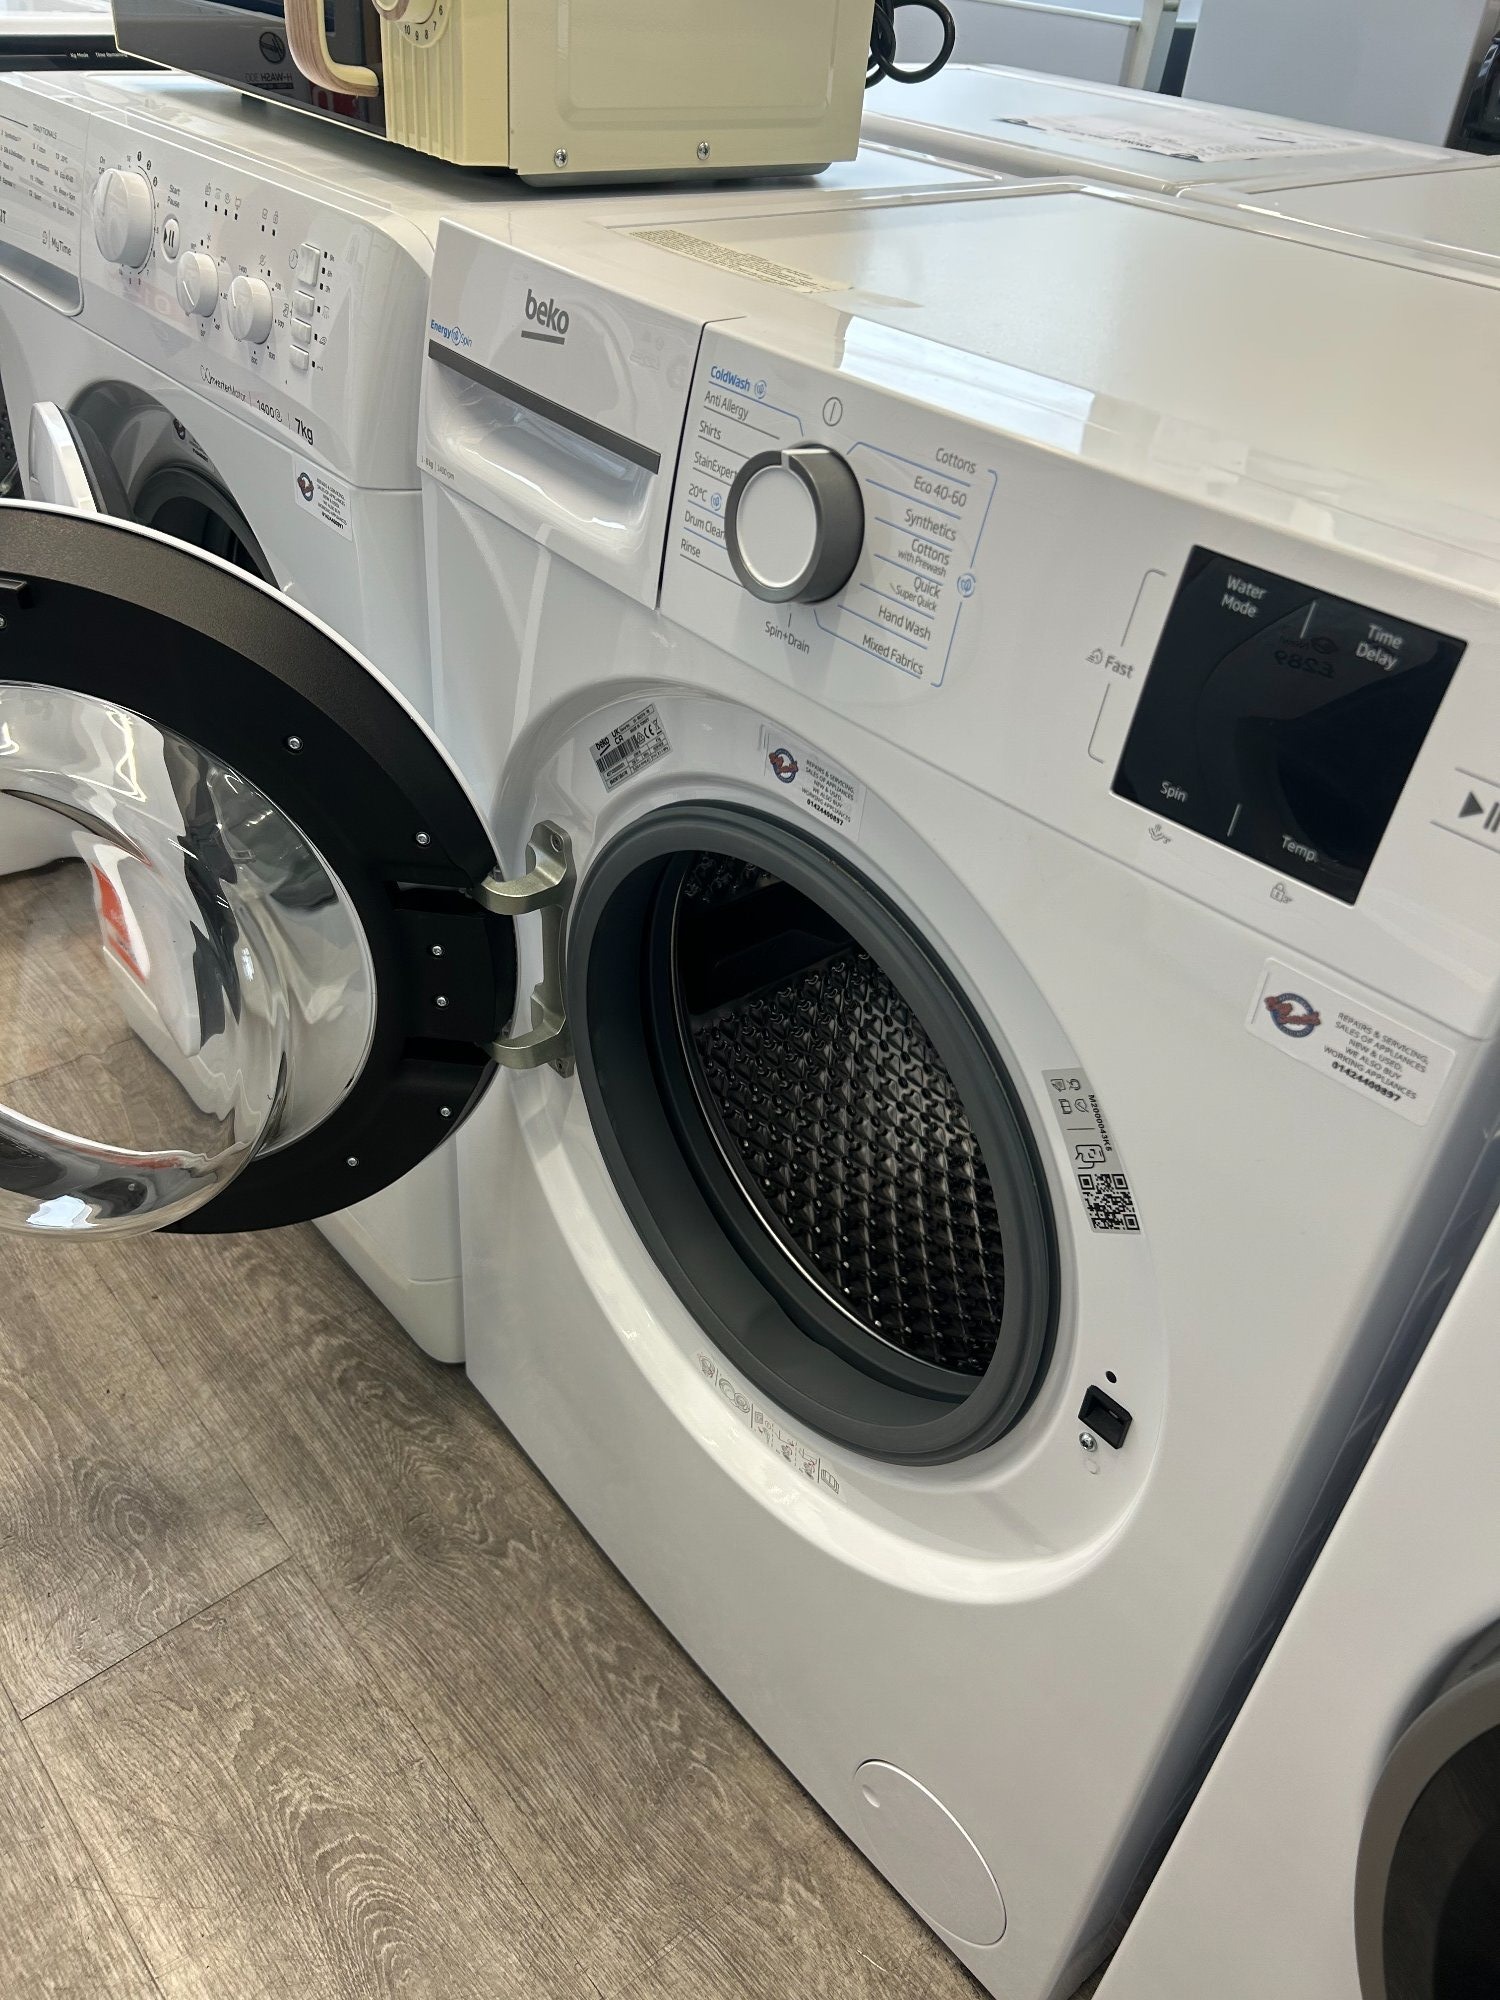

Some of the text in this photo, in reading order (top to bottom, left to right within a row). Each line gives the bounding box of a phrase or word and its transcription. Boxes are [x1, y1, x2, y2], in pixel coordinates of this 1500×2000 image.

[438, 5, 443, 15] 6
[404, 25, 411, 35] 10
[415, 31, 419, 40] 9
[425, 30, 428, 39] 8
[433, 21, 437, 31] 7
[167, 196, 180, 208] Pause
[169, 185, 180, 196] Start
[52, 237, 71, 256] MyTime
[525, 289, 569, 334] beko
[431, 319, 472, 347] Energy Spin
[710, 366, 750, 392] ColdWash
[257, 400, 274, 418] 1400
[704, 390, 749, 421] Anti Allergy
[295, 418, 313, 445] 7kg
[699, 420, 721, 440] Shirts
[694, 451, 738, 480] StainExpert
[935, 448, 976, 474] Cottons
[688, 483, 708, 502] 20°C
[914, 476, 967, 507] Eco 40-60
[684, 511, 704, 530] Drum
[904, 508, 956, 542] Synthetics
[681, 538, 700, 558] Rinse
[911, 538, 950, 566] Cottons
[898, 550, 946, 578] with Prewash
[896, 586, 936, 612] Super Quick
[914, 576, 940, 599] Quick
[1227, 574, 1266, 600] Water
[1221, 594, 1257, 618] Mode
[878, 605, 931, 642] Hand Wash
[1369, 623, 1404, 649] Time
[765, 621, 810, 654] Spin+Drain
[862, 633, 923, 676] Mixed Fabrics
[1105, 655, 1134, 679] Fast
[1355, 641, 1398, 671] Delay
[611, 728, 620, 737] UK
[615, 734, 623, 744] CA
[1160, 780, 1188, 803] Spin
[1282, 834, 1318, 862] Temp.
[1338, 1012, 1372, 1034] REPAIRS
[1335, 1021, 1426, 1073] SALES OF APPLIANCES
[1349, 1039, 1369, 1053] NEW
[1324, 1044, 1417, 1099] WORKING APPLIANCES
[1345, 1046, 1402, 1080] WE ALSO BUY
[1332, 1061, 1401, 1101] 01424400897
